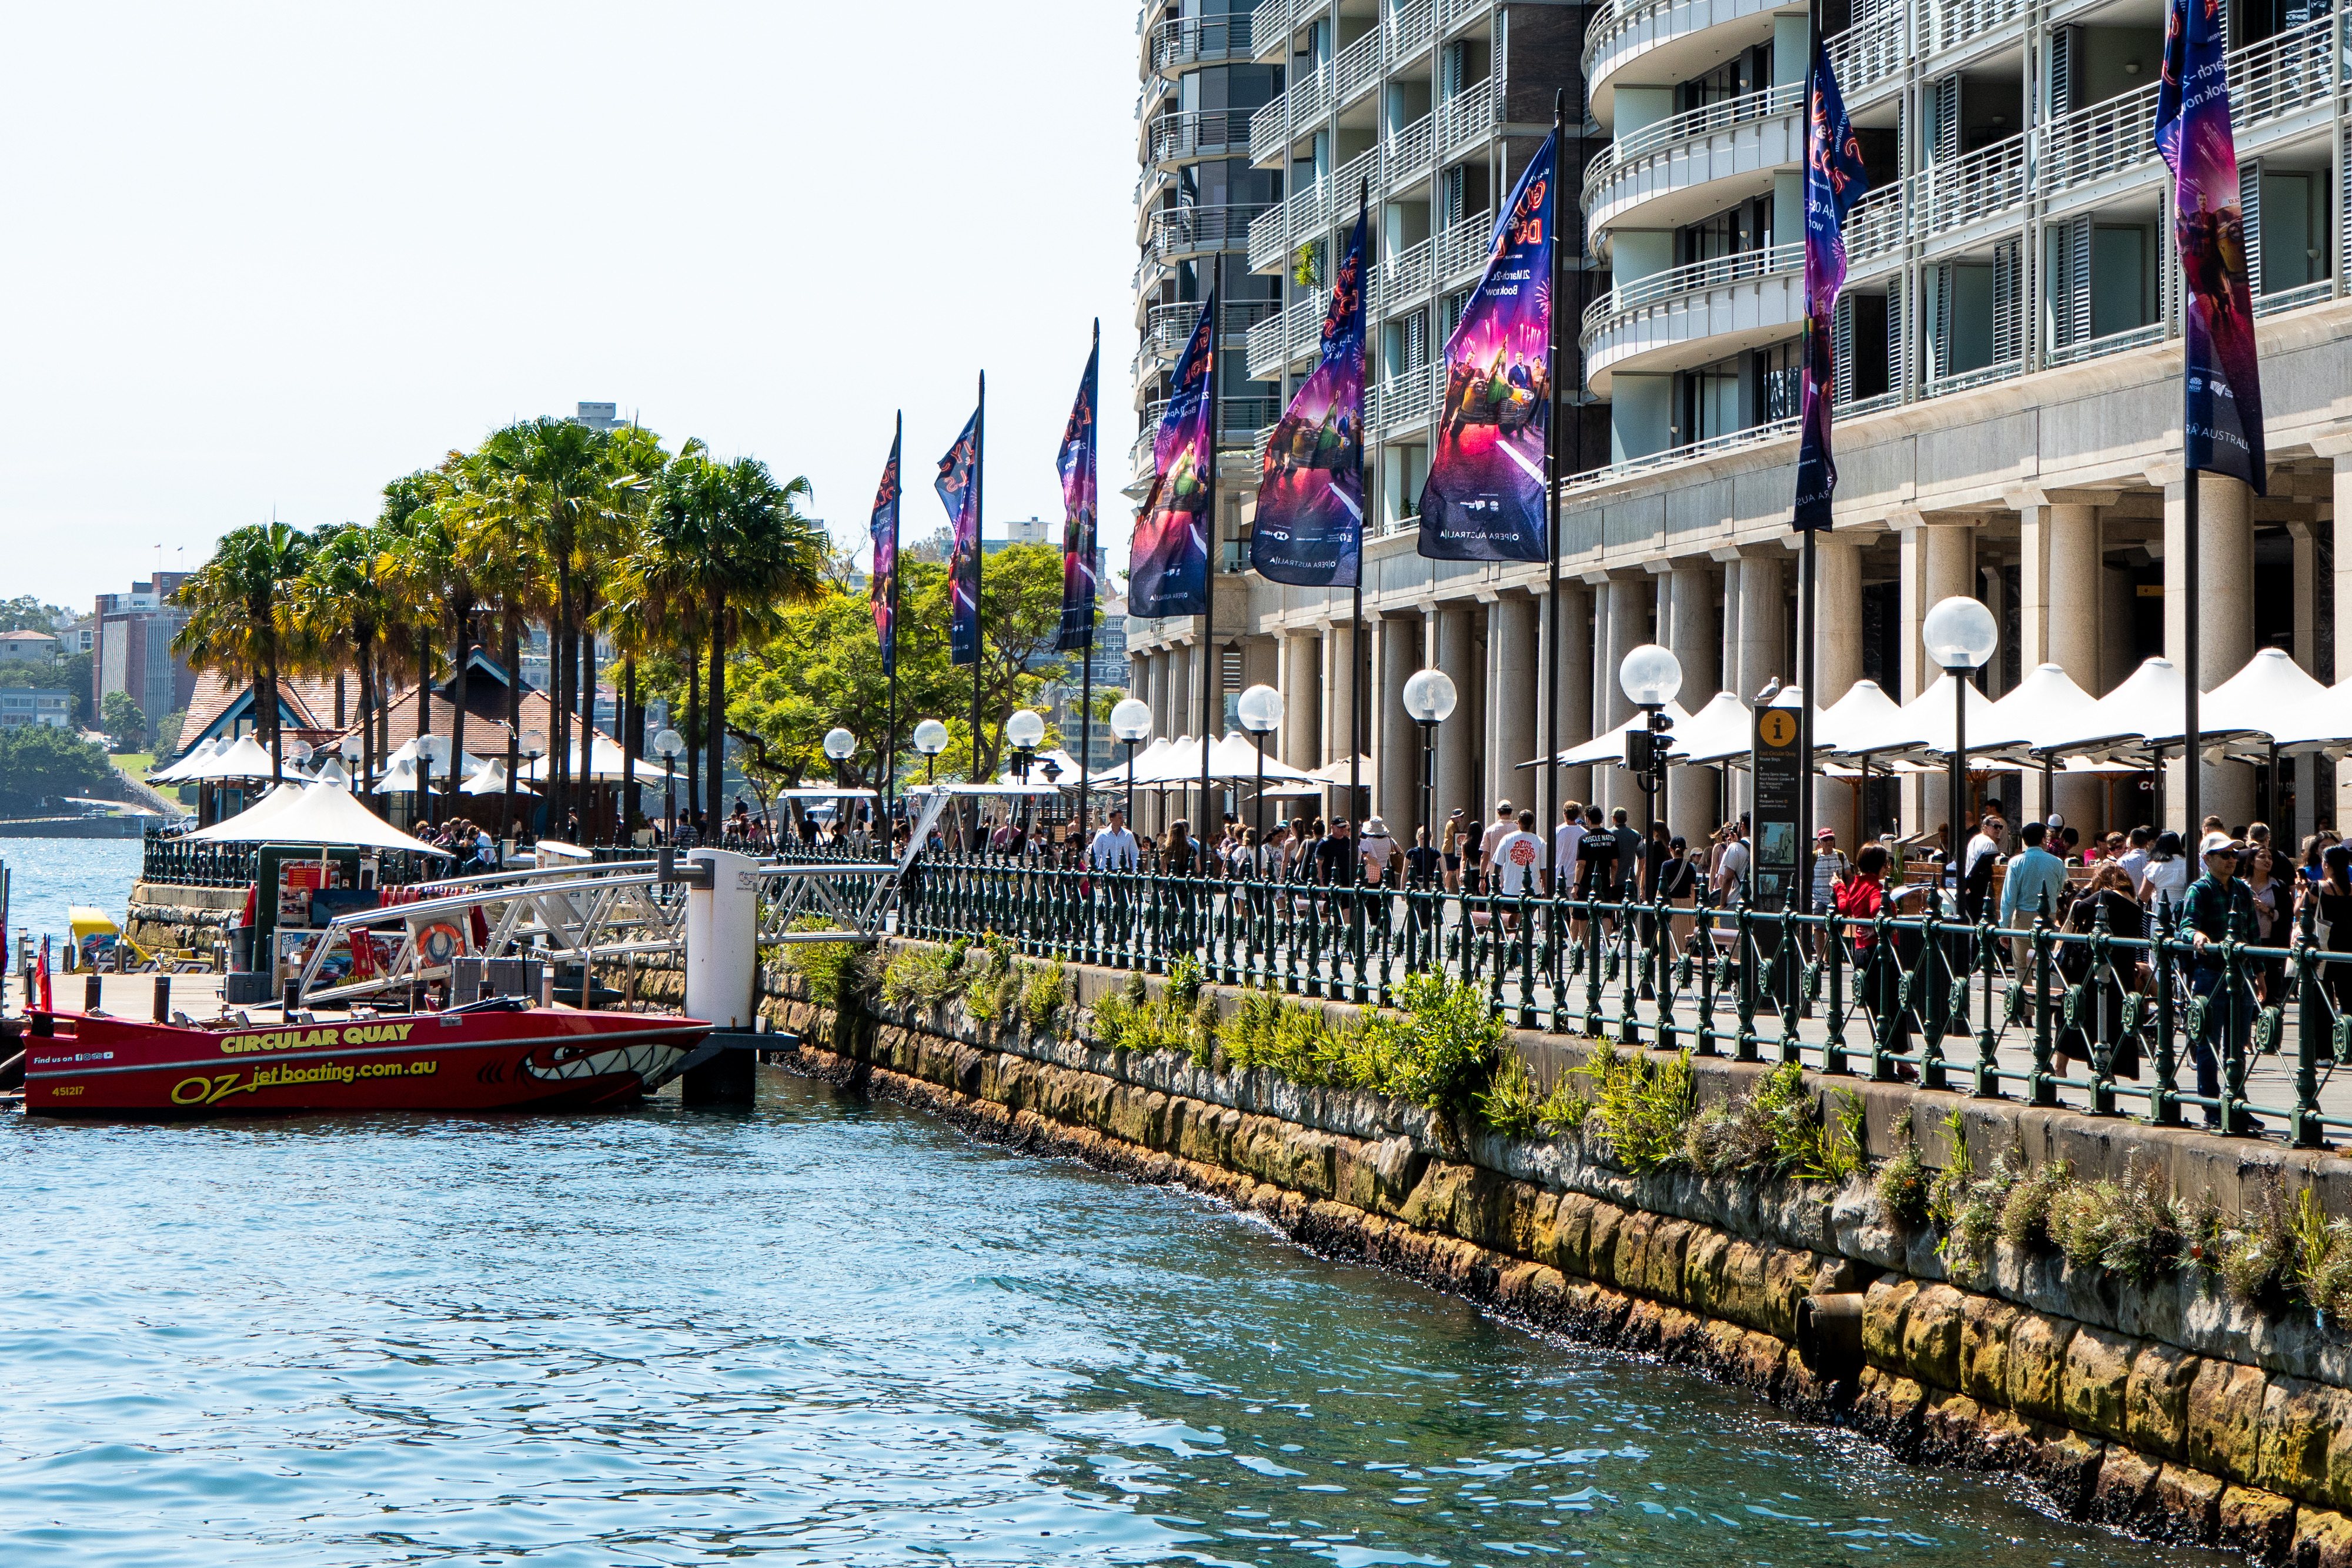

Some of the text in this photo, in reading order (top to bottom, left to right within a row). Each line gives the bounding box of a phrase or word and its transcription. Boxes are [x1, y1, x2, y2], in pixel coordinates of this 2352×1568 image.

[1822, 204, 1835, 219] Ap
[2201, 428, 2250, 454] AUSTRALI
[282, 934, 294, 945] GET
[283, 942, 303, 954] YOUR
[220, 1024, 415, 1054] CIRCULAR QUAY
[34, 1056, 51, 1064] Find
[52, 1086, 85, 1096] 451217
